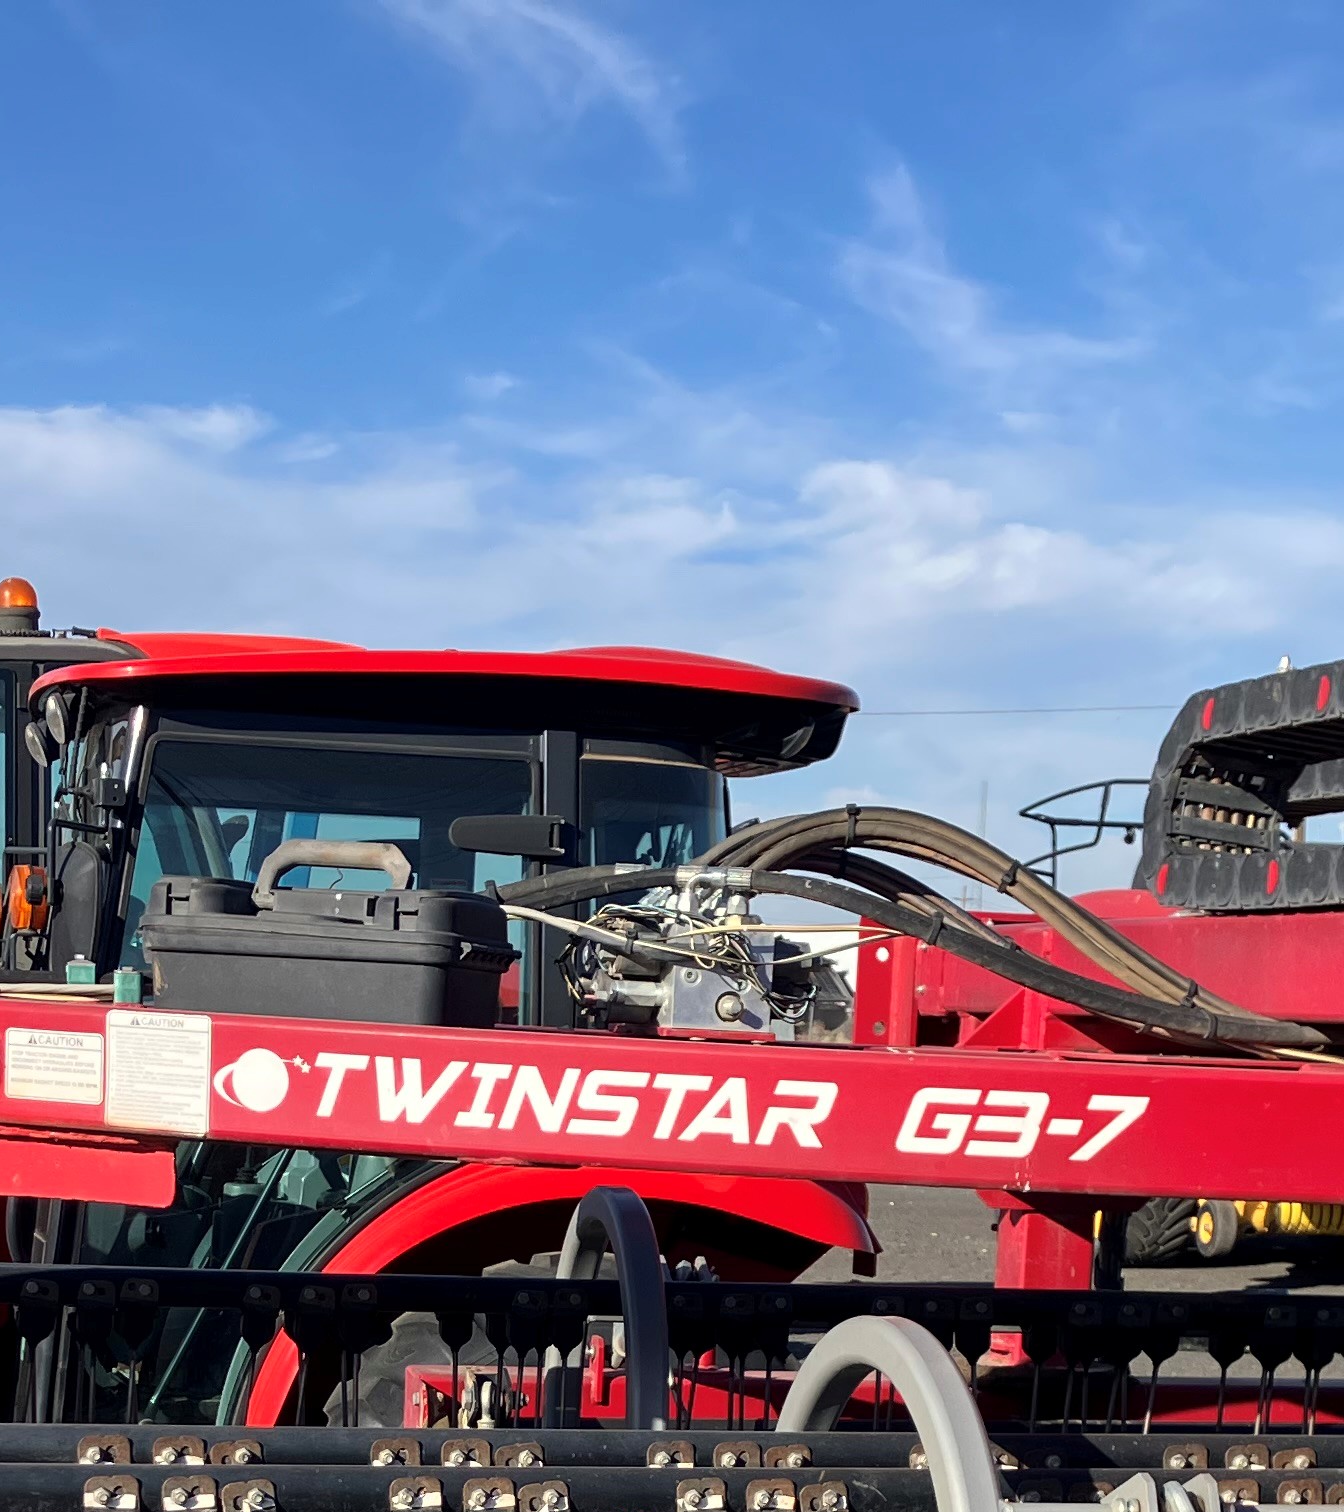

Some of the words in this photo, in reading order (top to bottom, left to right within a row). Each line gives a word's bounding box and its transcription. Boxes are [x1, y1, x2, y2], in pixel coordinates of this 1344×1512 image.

[141, 1017, 184, 1028] CAUTION
[38, 1035, 84, 1047] CAUTION
[314, 1052, 838, 1148] TWINSTAR
[895, 1087, 1150, 1161] G3-7
